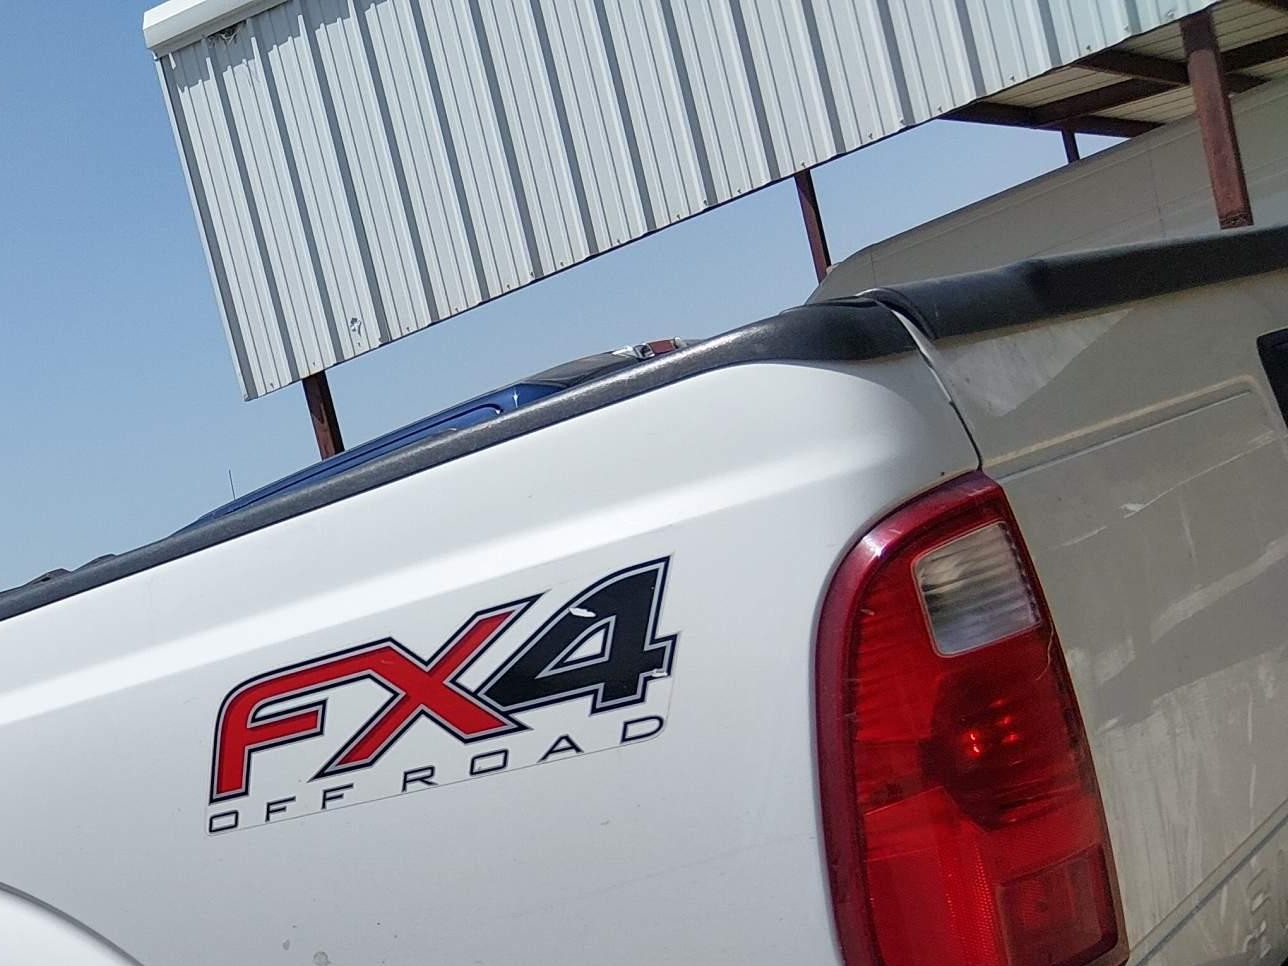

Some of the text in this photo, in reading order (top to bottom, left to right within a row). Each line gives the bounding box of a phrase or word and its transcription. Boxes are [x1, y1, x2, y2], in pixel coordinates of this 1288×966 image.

[208, 555, 680, 805] FX4
[208, 713, 665, 834] OFF ROAD
